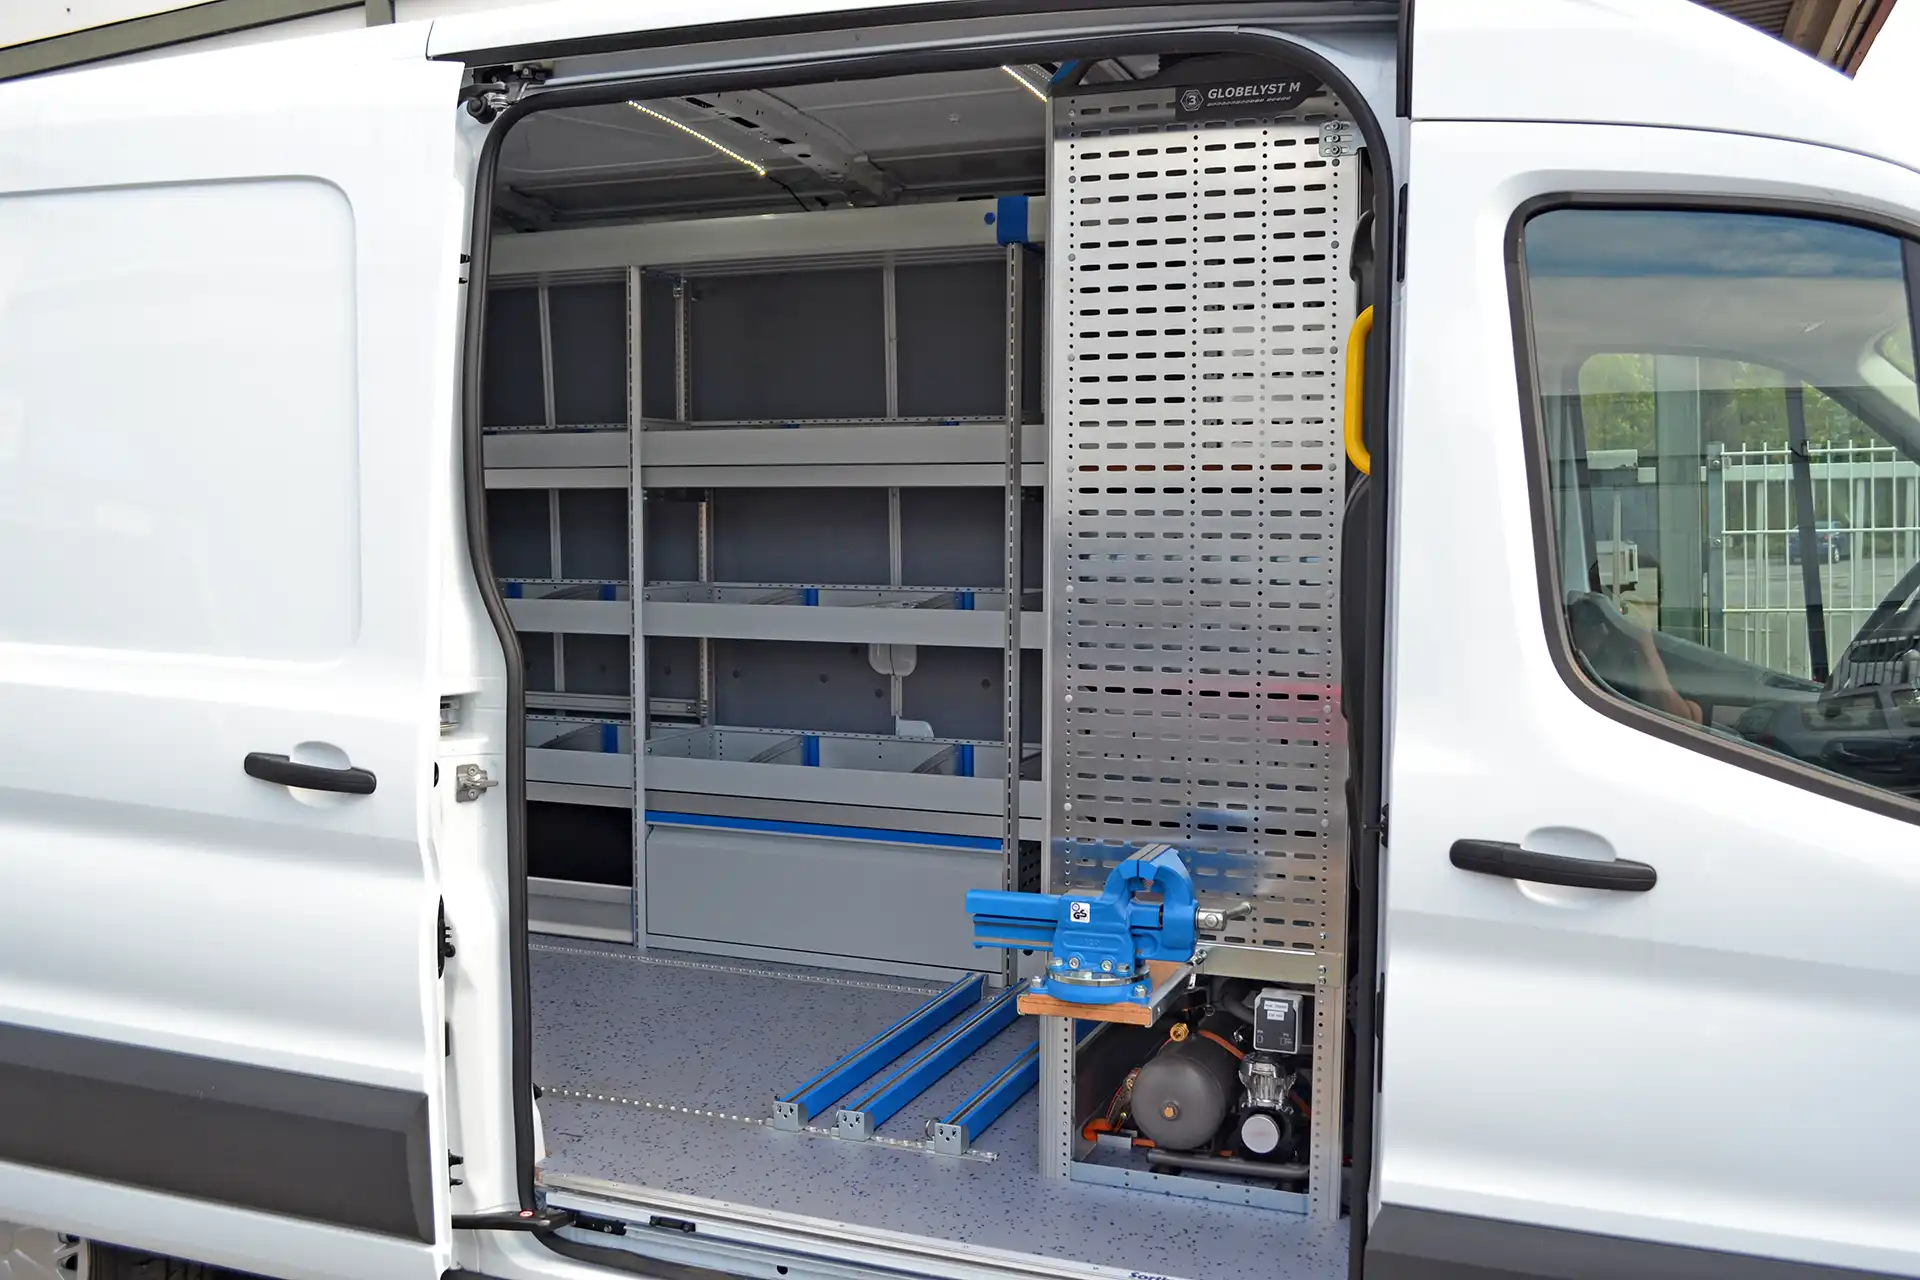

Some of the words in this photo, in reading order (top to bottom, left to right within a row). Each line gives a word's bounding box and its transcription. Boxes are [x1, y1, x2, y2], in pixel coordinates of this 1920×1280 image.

[1207, 83, 1286, 99] GLOBELYST
[1289, 82, 1301, 93] M
[1188, 95, 1197, 105] 3
[1073, 909, 1087, 920] GS
